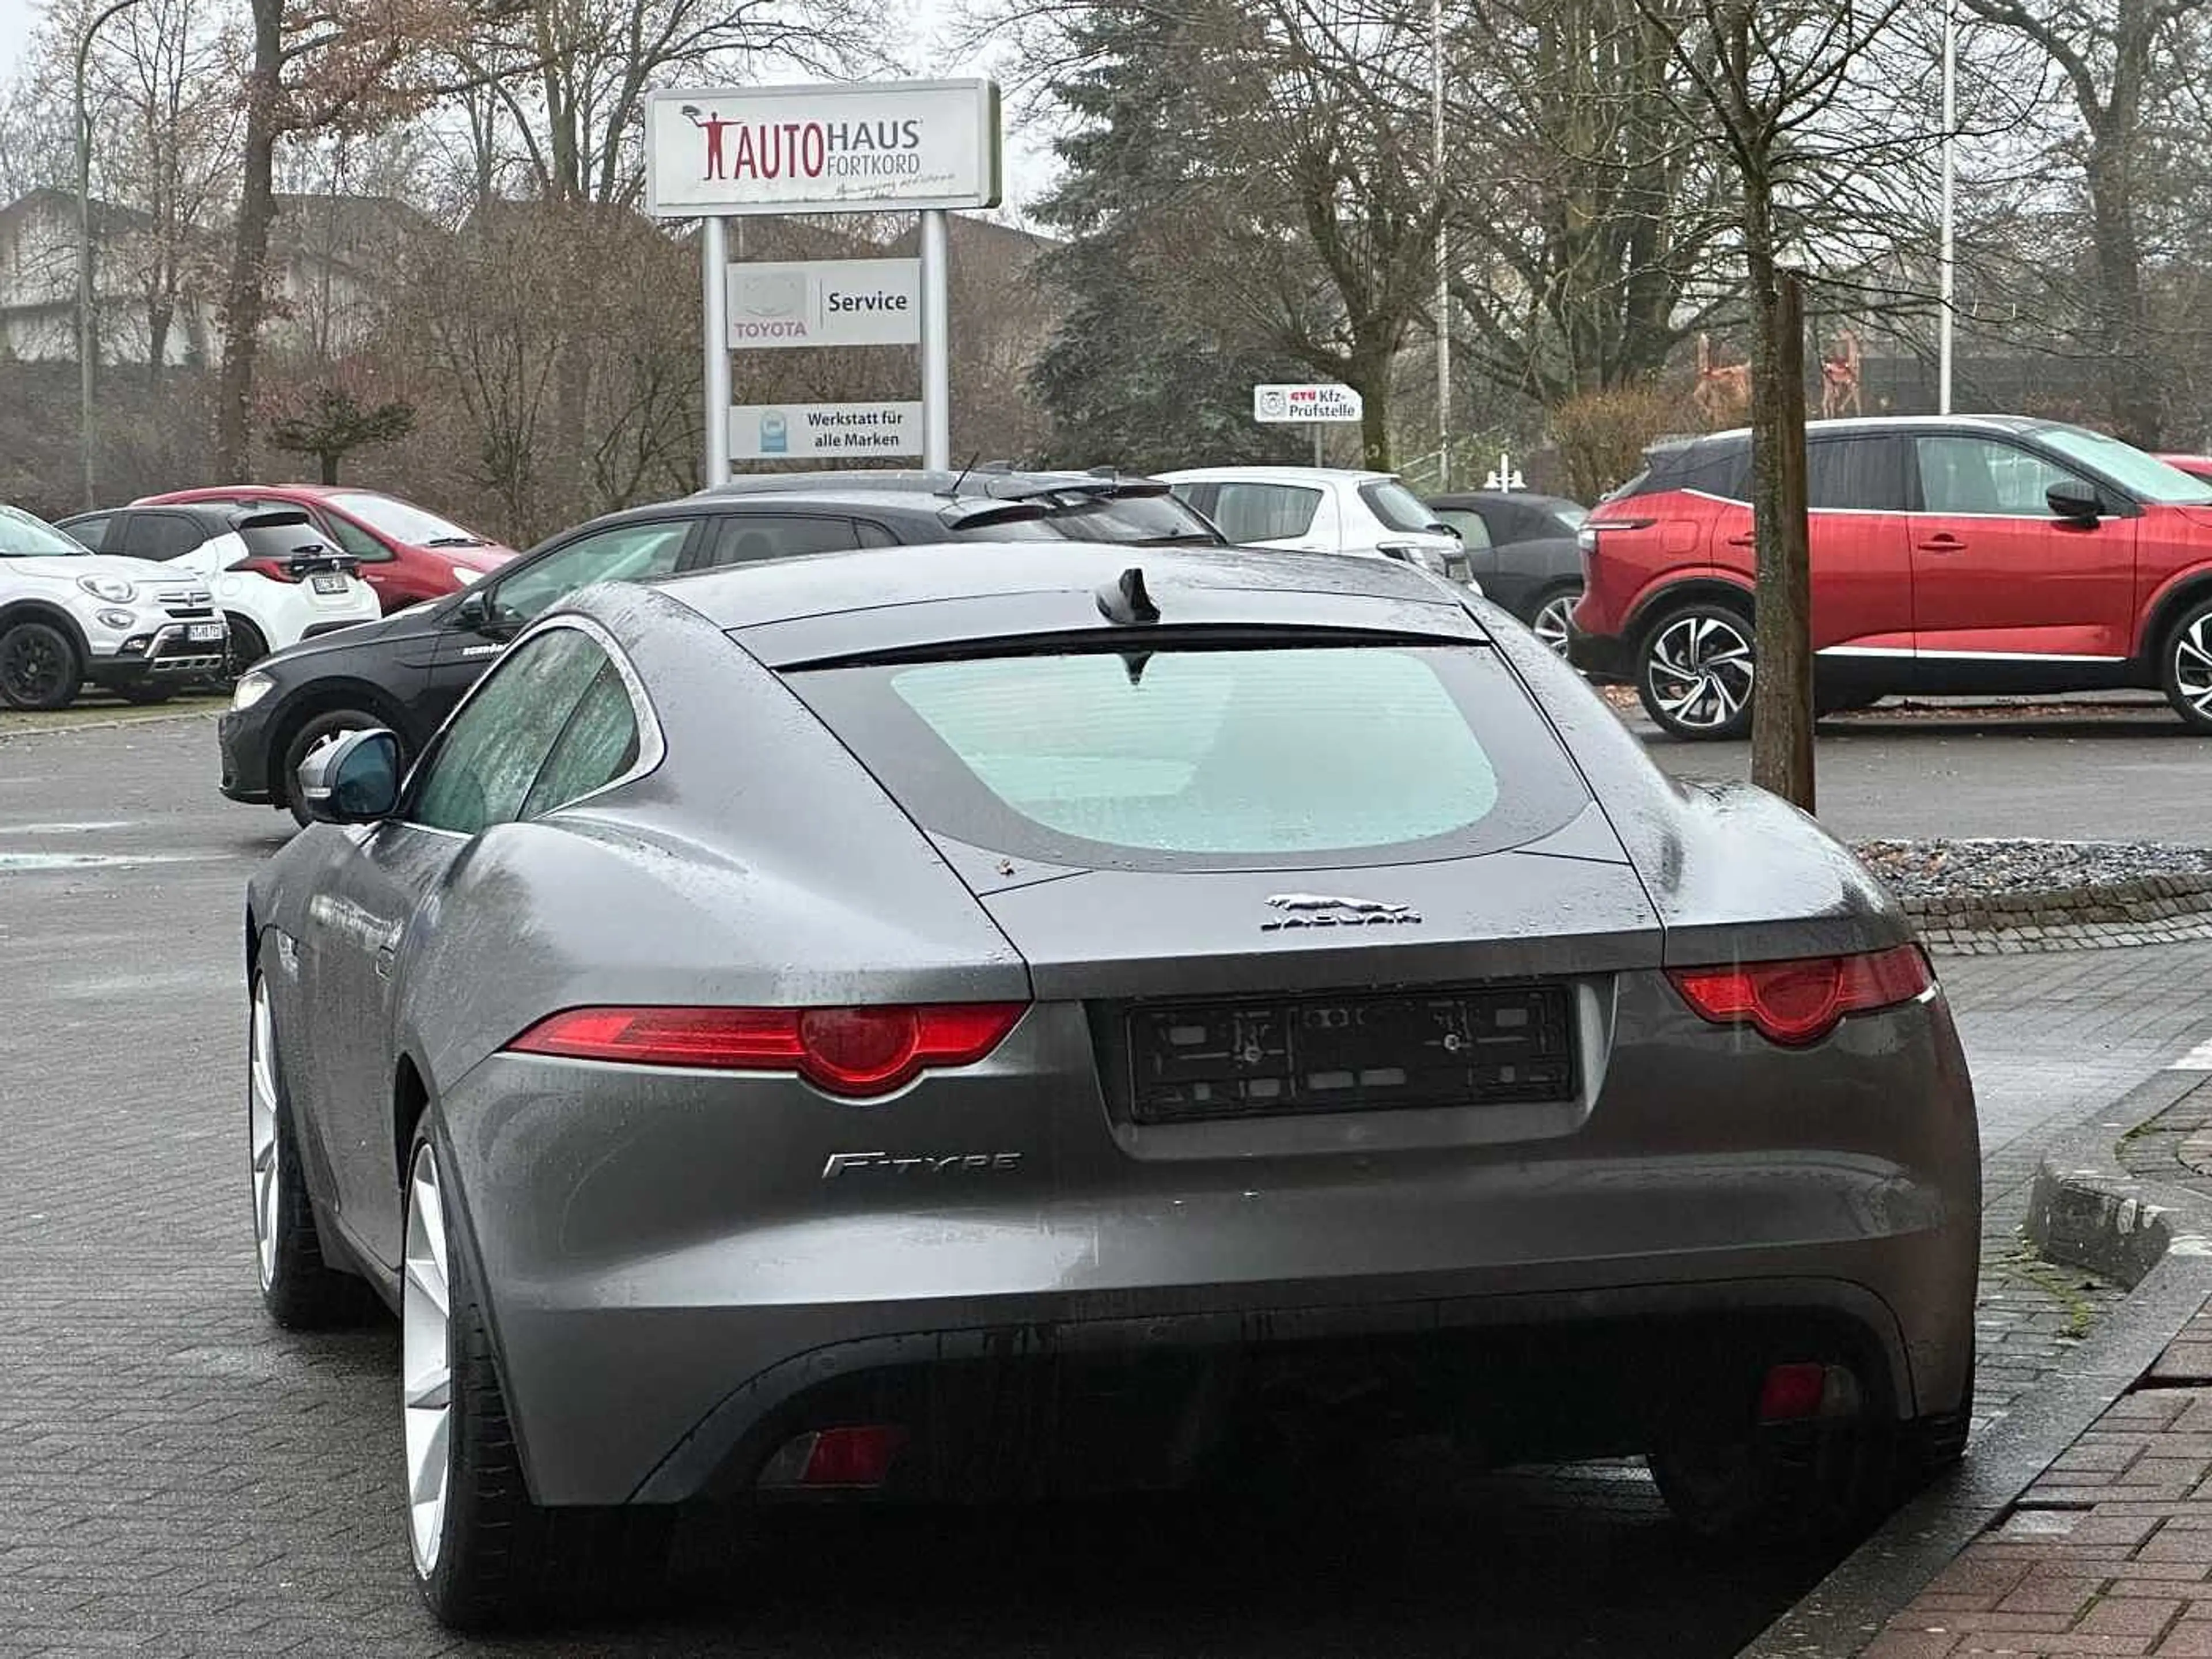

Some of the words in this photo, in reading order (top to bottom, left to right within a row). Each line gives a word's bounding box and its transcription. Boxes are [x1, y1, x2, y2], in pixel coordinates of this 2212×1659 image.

[827, 153, 921, 177] FORTKORD
[828, 291, 908, 312] Service
[734, 321, 806, 339] TOYOTA
[1319, 389, 1347, 403] Kfz-
[808, 411, 878, 427] Werkstatt
[882, 410, 903, 425] für
[1289, 403, 1355, 417] Prüfstelle
[815, 433, 842, 448] alle
[844, 432, 899, 447] Marken
[821, 1150, 1022, 1179] F-TYPE
